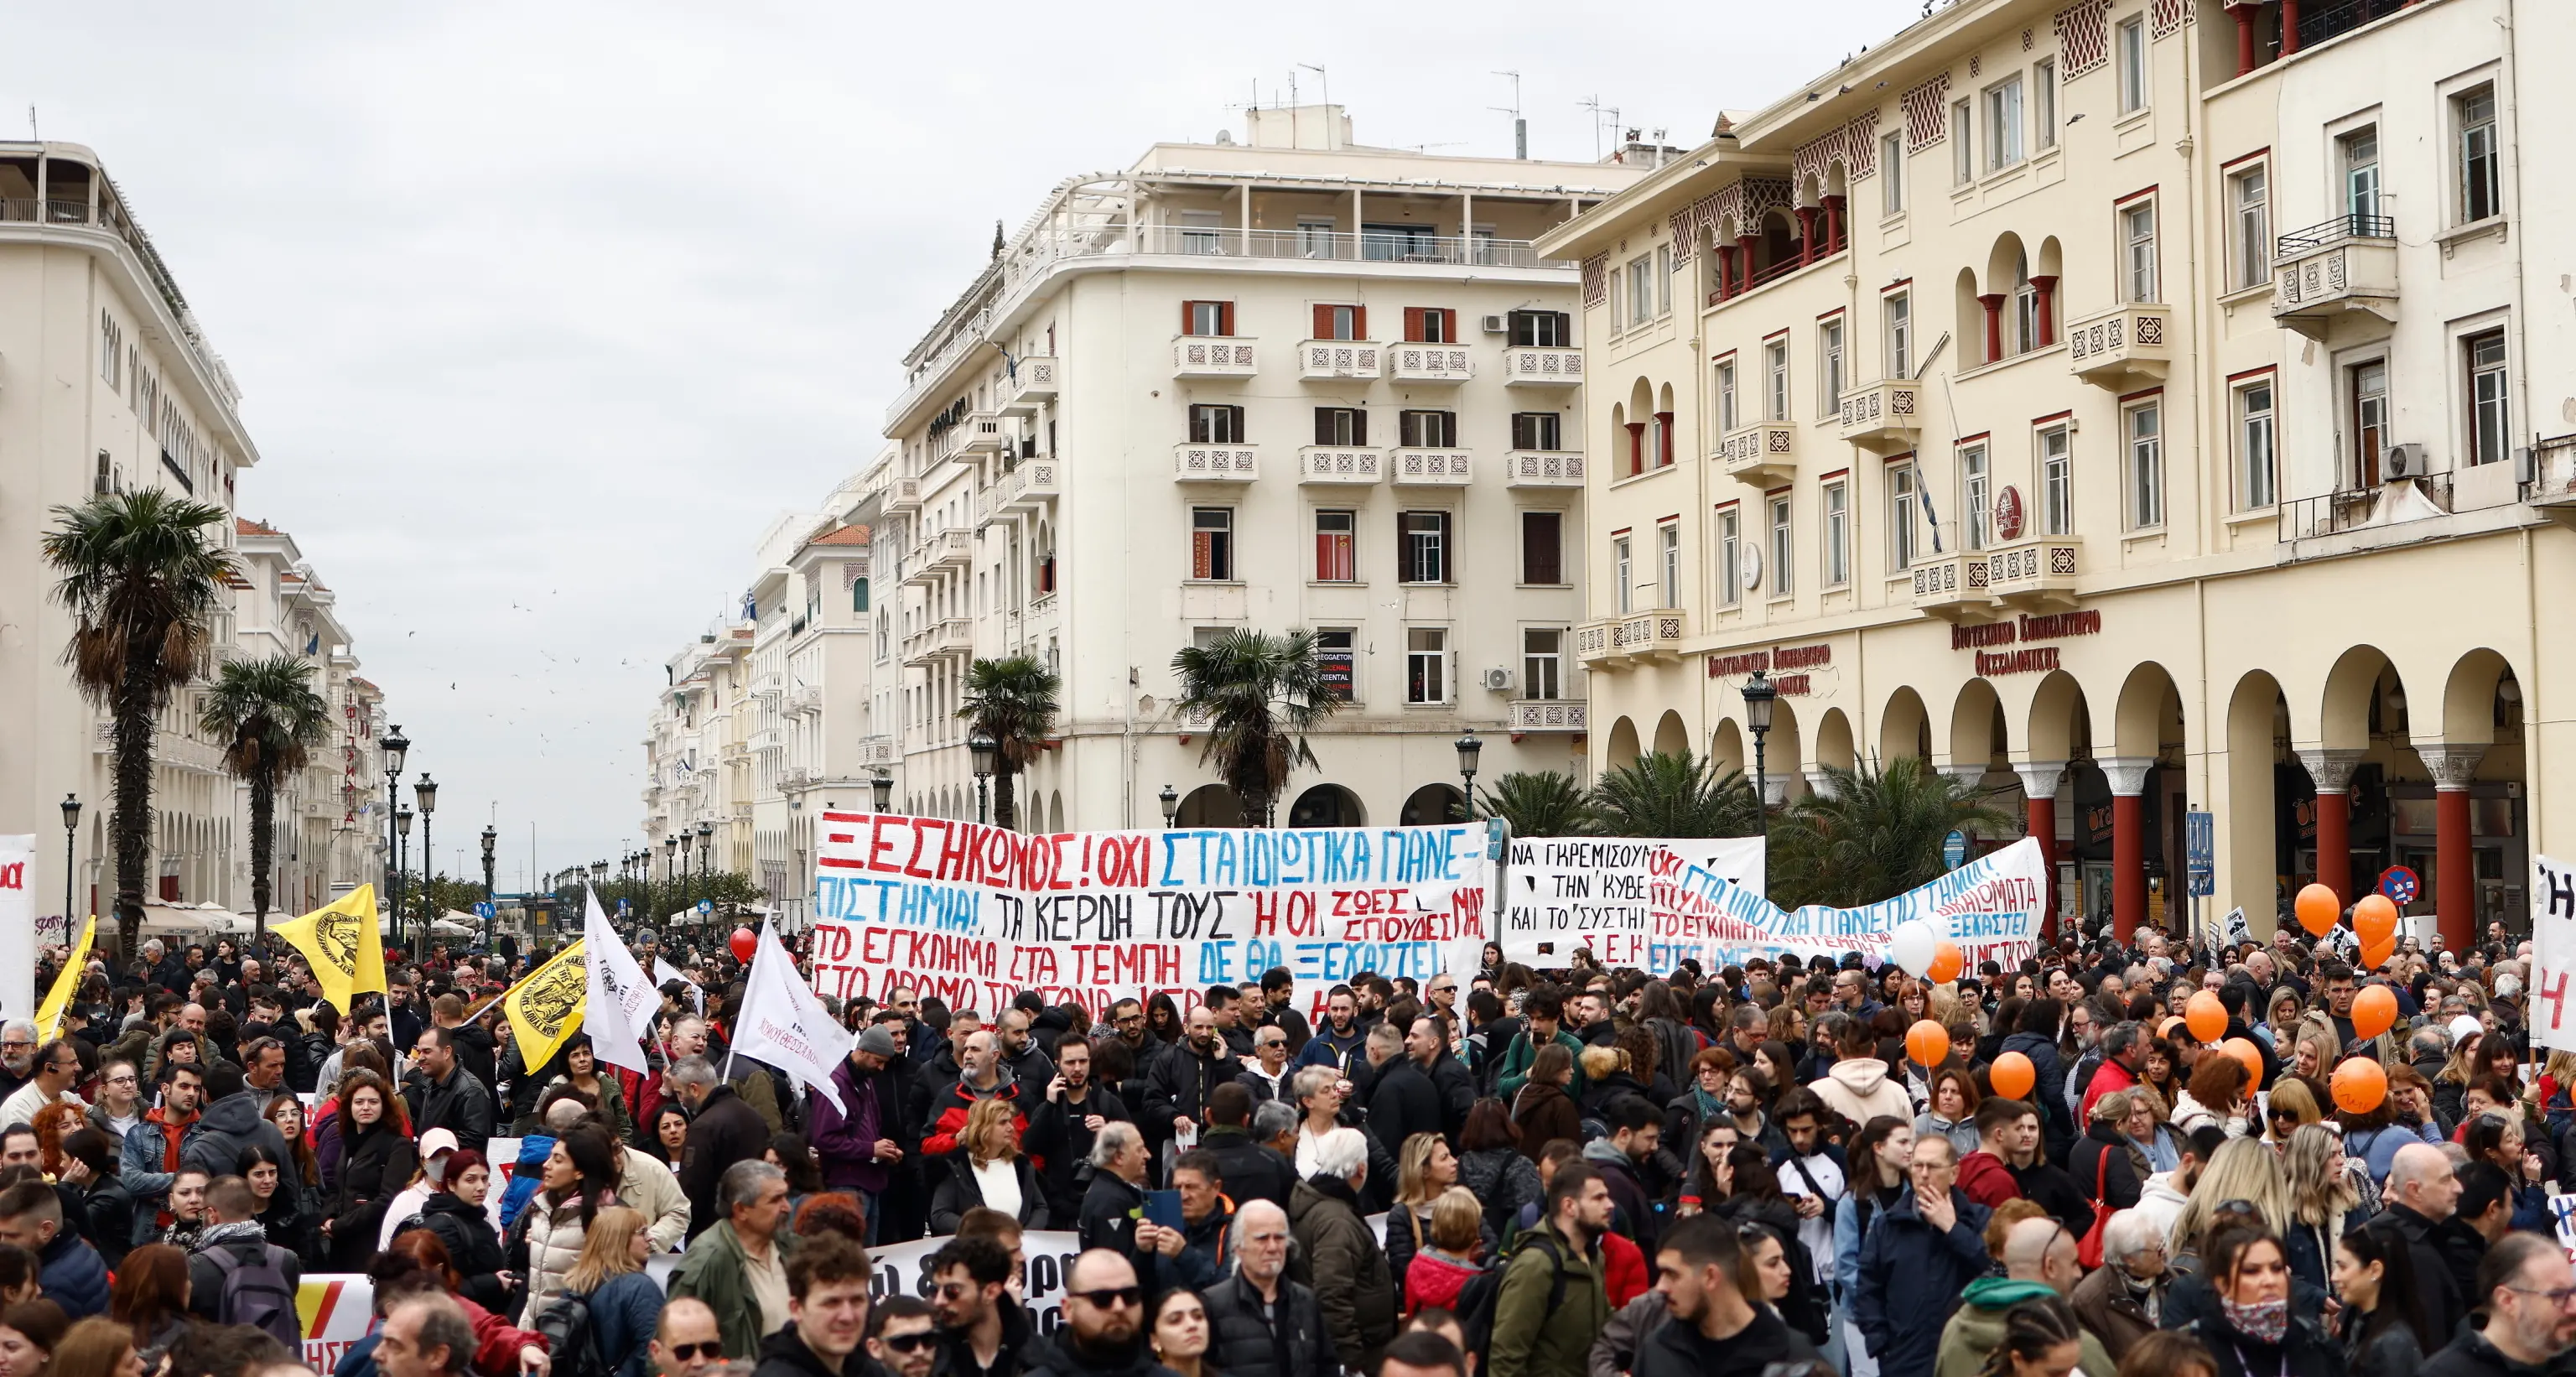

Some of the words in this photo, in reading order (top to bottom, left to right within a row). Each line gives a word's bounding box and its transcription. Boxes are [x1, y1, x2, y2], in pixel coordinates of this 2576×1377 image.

[1951, 621, 2016, 650] ΒΙΟΤΕΧΝΙΚΟ
[2019, 609, 2101, 642] ΕΠΙΜΕΛΗΤΗΡΙΟ
[1975, 647, 2060, 677] ΘΕΣΣΑΛΟΝΙΚΗΣ
[818, 812, 1092, 891] ΞΕΣΗΚΩΜΟΣ!
[1098, 835, 1150, 887] ΟΧΙ
[1160, 830, 1237, 886] ΣΤΑ
[1243, 830, 1372, 887] ΙΔΙΩΤΙΚΑ
[1381, 829, 1479, 884] ΠΑΝΕ-
[1512, 844, 1535, 865] ΝΑ
[815, 876, 979, 937] ΠΙΣΤΗΜΙΑ!
[995, 893, 1024, 942] ΤΑ
[1036, 894, 1132, 942] ΚΕΡΔΗ
[1148, 891, 1238, 939] ΤΟΥΣ
[1286, 891, 1316, 938] ΟΙ
[1331, 888, 1409, 916] ΖΩΕΣ
[1452, 887, 1486, 940] ΜΑΣ
[1512, 907, 1536, 930] ΚΑΙ
[1546, 907, 1568, 930] ΤΟ
[1650, 912, 1680, 937] ΤΟ
[1343, 912, 1452, 942] ΣΠΟΥΔΕΣ
[815, 923, 851, 963] ΤΟ
[863, 926, 997, 978] ΕΓΚΛΗΜΑ
[1009, 945, 1058, 985] ΣΤΑ
[1071, 943, 1181, 985] ΤΕΜΠΗ
[1199, 941, 1237, 984] ΔΕ
[1246, 938, 1283, 983] ΘΑ
[1294, 940, 1439, 981] ΞΕΧΑΣΤΕΙ
[813, 964, 870, 1003] ΣΤΟ
